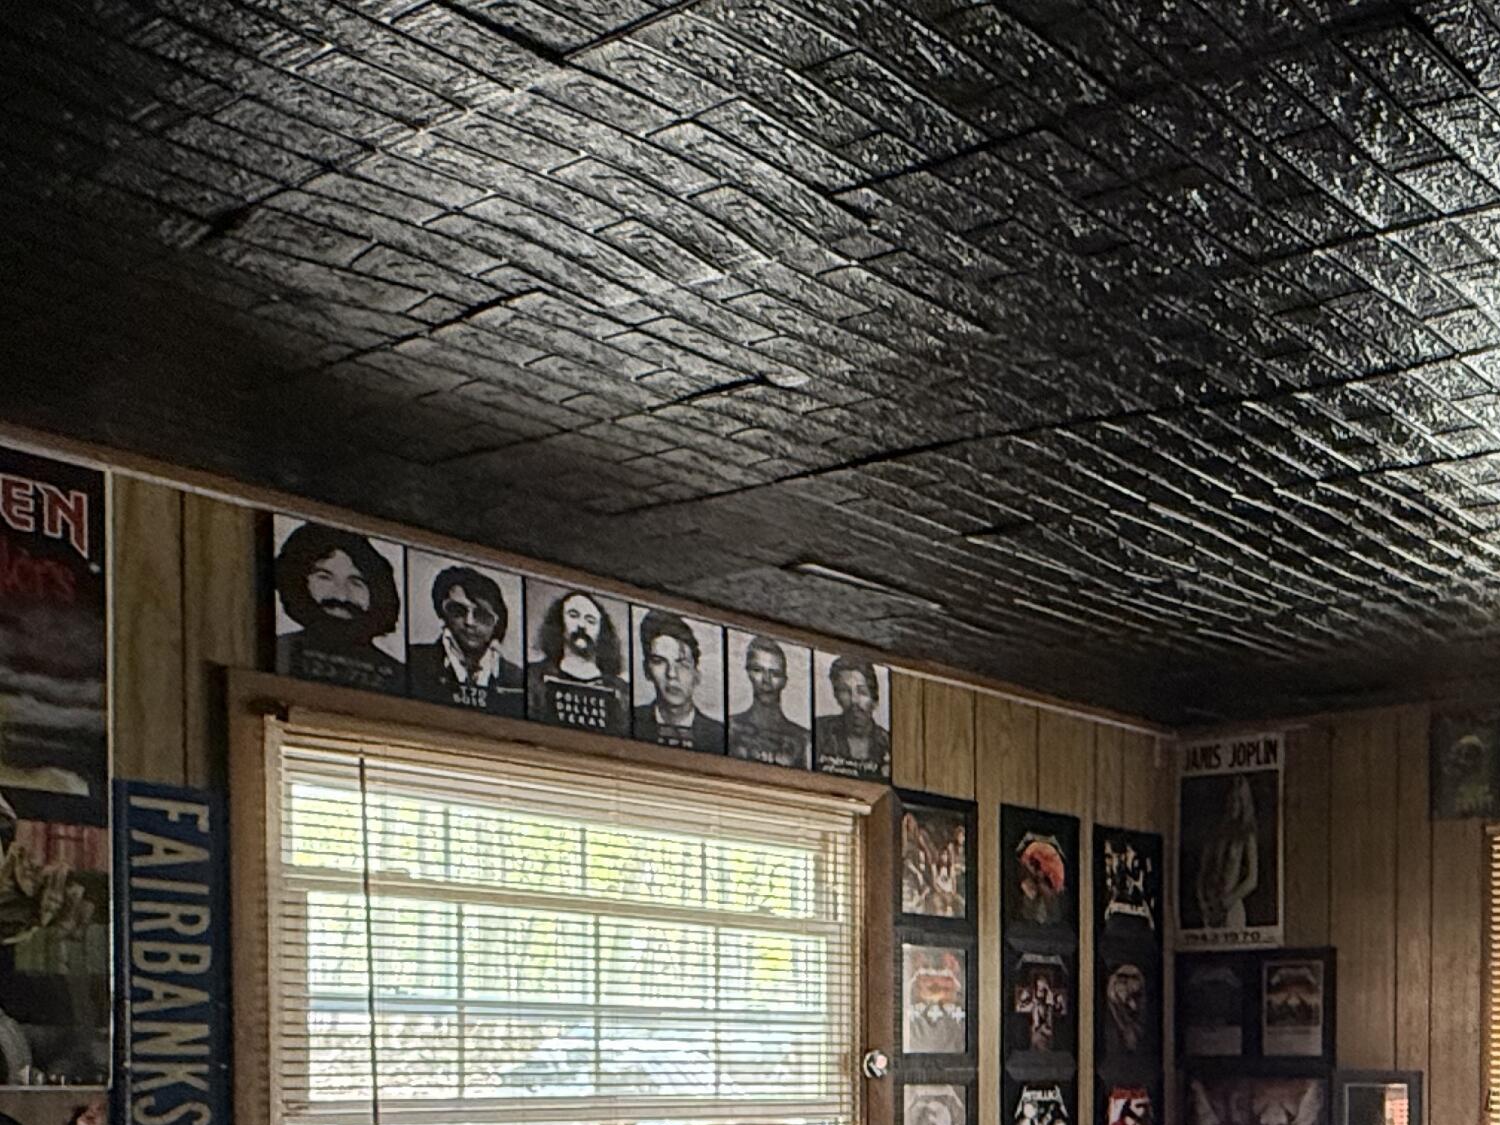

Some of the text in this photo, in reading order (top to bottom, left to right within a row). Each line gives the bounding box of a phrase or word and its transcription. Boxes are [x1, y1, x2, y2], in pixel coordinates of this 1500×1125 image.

[555, 690, 606, 707] POLICE
[556, 701, 606, 718] DALLAS
[1184, 739, 1277, 771] JANIS JOPLIN
